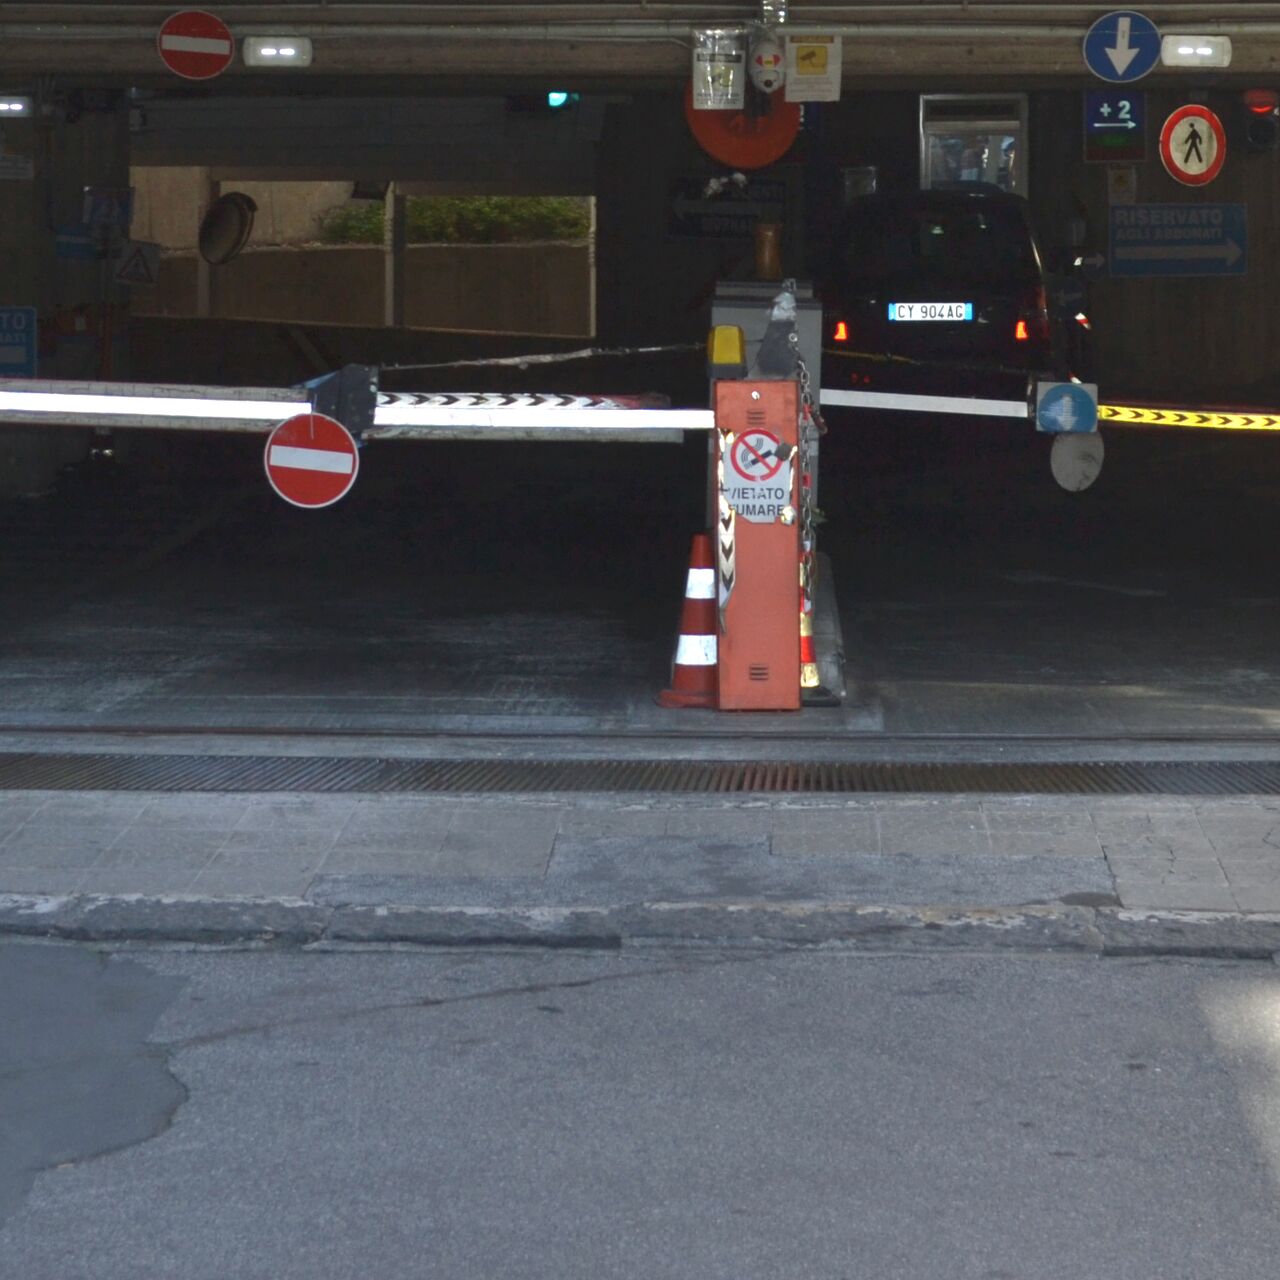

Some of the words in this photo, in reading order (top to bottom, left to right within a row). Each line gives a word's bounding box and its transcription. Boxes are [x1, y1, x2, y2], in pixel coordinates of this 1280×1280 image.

[1114, 208, 1224, 226] RISERVATO
[897, 304, 914, 319] CY
[920, 304, 963, 319] 904AG
